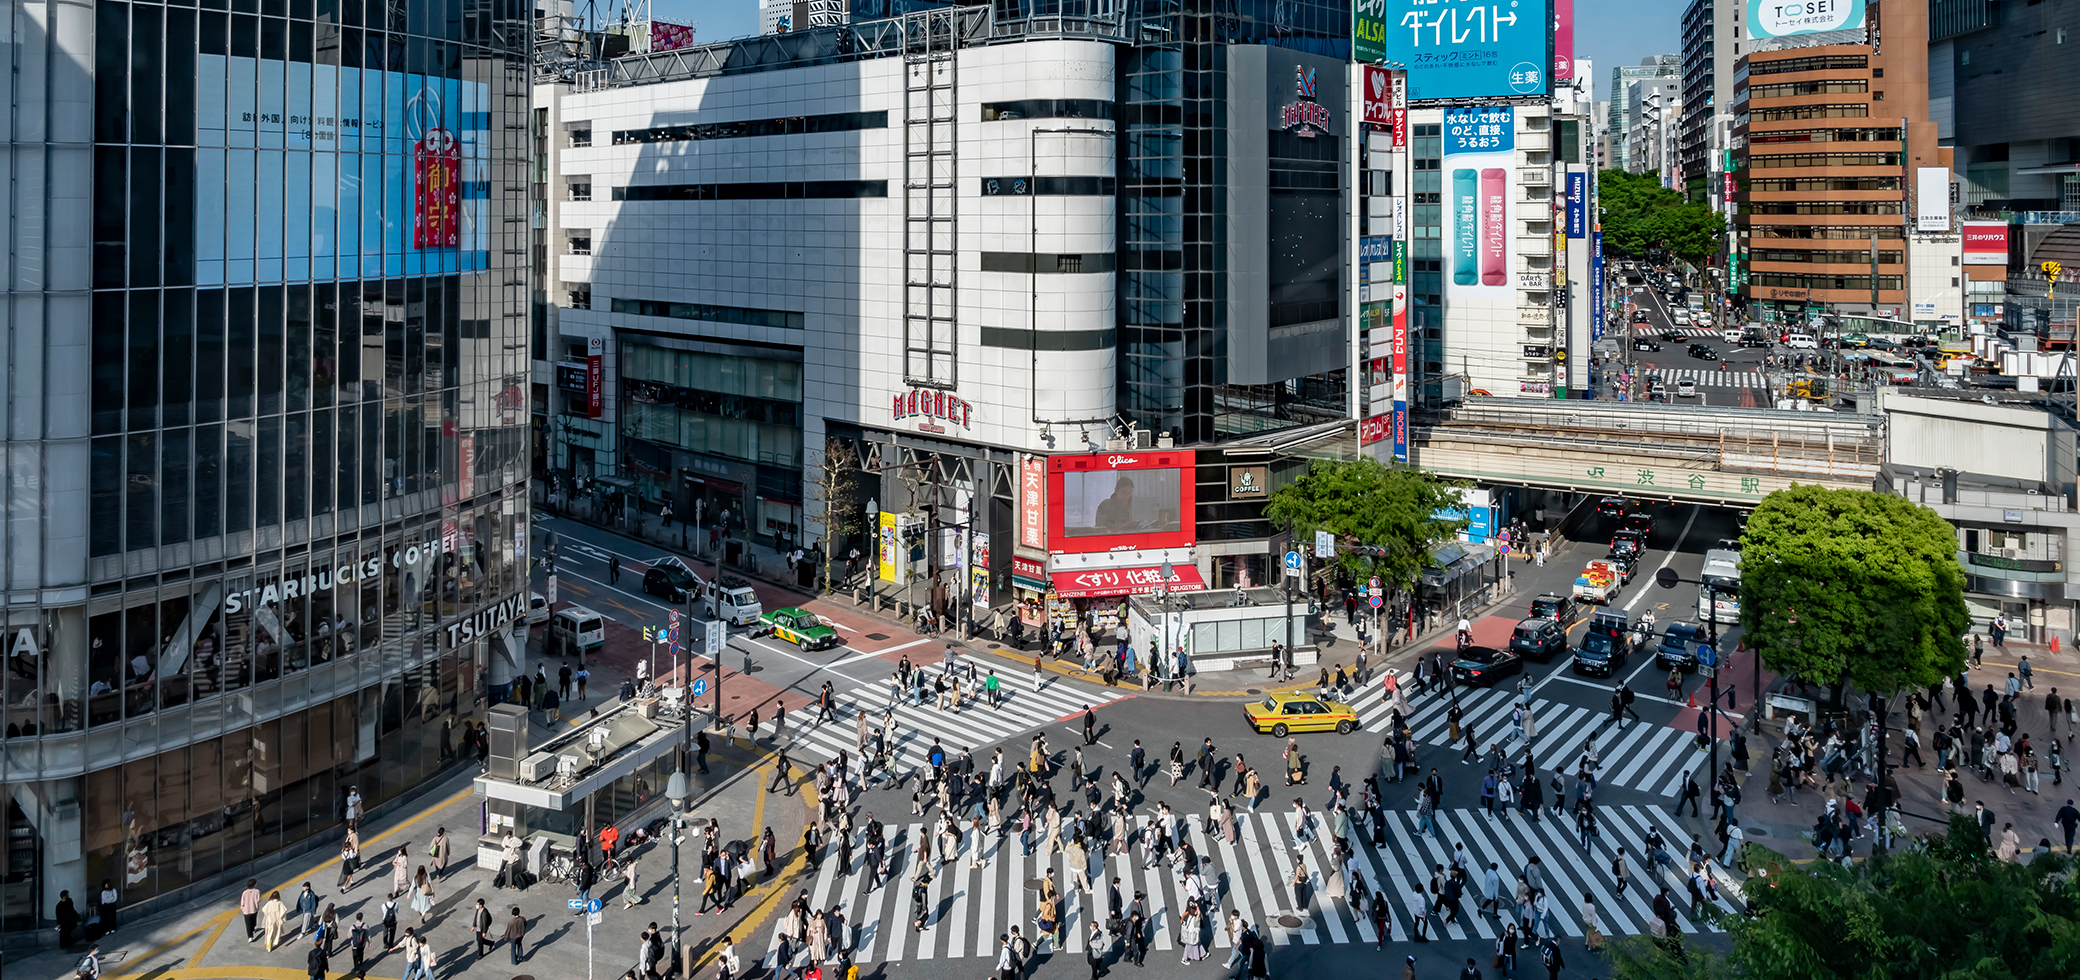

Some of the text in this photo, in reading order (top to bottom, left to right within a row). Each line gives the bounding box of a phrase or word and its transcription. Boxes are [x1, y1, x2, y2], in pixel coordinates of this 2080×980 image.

[1774, 0, 1834, 18] TOSEI
[1401, 5, 1517, 47] ダイレクト
[1775, 15, 1834, 27] トーセイ株式会社
[1357, 18, 1386, 43] ALSA
[1414, 51, 1459, 62] スティック
[1511, 71, 1539, 85] 生薬
[1283, 101, 1331, 132] MAGNET
[1365, 100, 1391, 120] アイフル
[1446, 112, 1511, 125] 水なしで飲む
[1395, 118, 1404, 146] アイフル
[1451, 124, 1505, 136] のど、直接、
[1457, 136, 1500, 148] うるおう
[1395, 329, 1404, 354] アコム
[893, 390, 973, 431] MAGNET
[1362, 421, 1382, 440] アコム
[1396, 411, 1405, 445] PROMISE
[1107, 455, 1138, 468] Glico
[1587, 467, 1604, 478] JR
[1637, 469, 1760, 494] 渋谷駅
[1234, 485, 1260, 493] COFFEE
[1026, 472, 1039, 545] 天津甘栗
[1014, 560, 1042, 576] 天津甘栗
[225, 557, 379, 614] STARBUCKS
[1075, 572, 1119, 587] くすり
[1170, 584, 1202, 592] DRUGSTORE
[447, 592, 526, 649] TSUTAYA
